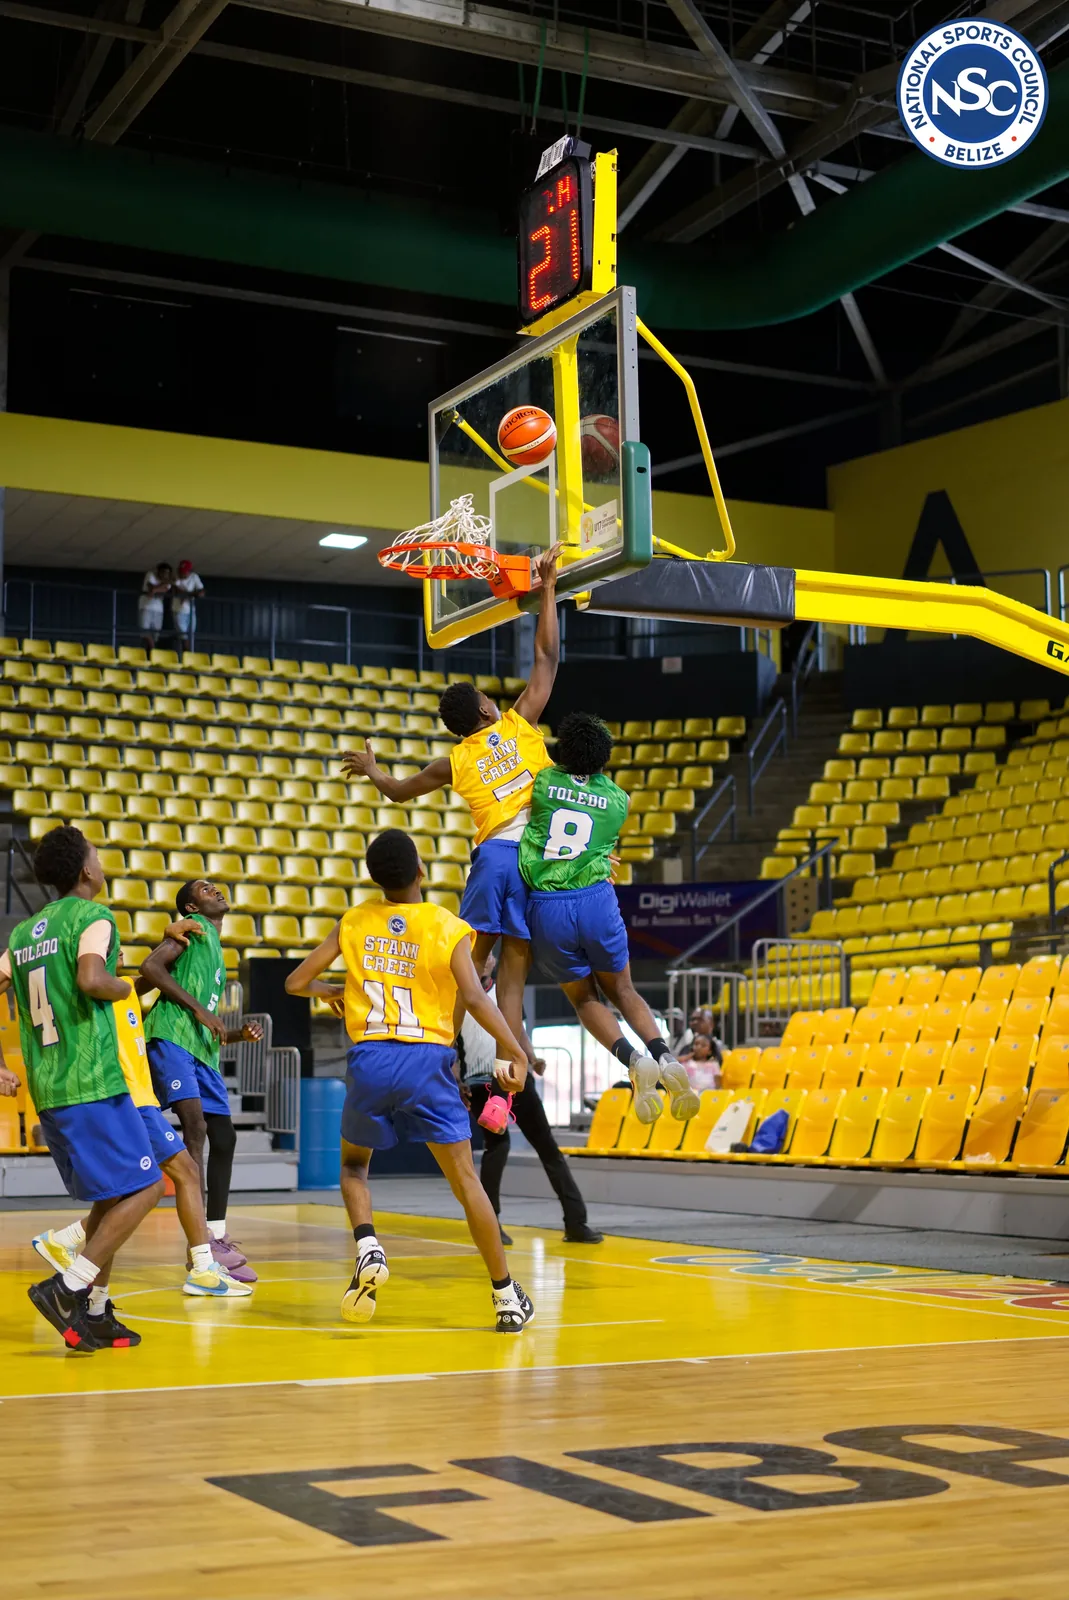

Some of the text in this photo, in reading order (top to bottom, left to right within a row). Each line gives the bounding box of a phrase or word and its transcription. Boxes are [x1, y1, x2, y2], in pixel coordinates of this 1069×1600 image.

[530, 208, 580, 311] 21
[503, 409, 538, 432] molten
[1047, 640, 1069, 663] G
[476, 736, 518, 773] STANN
[480, 751, 523, 785] CREEK
[548, 785, 608, 810] TOLEDO
[542, 807, 595, 861] 8
[639, 891, 732, 914] DigiWallet
[14, 937, 59, 966] TOLEDO
[364, 935, 420, 960] STANN
[363, 954, 415, 978] CREEK
[28, 964, 60, 1048] 4
[363, 980, 424, 1038] 11
